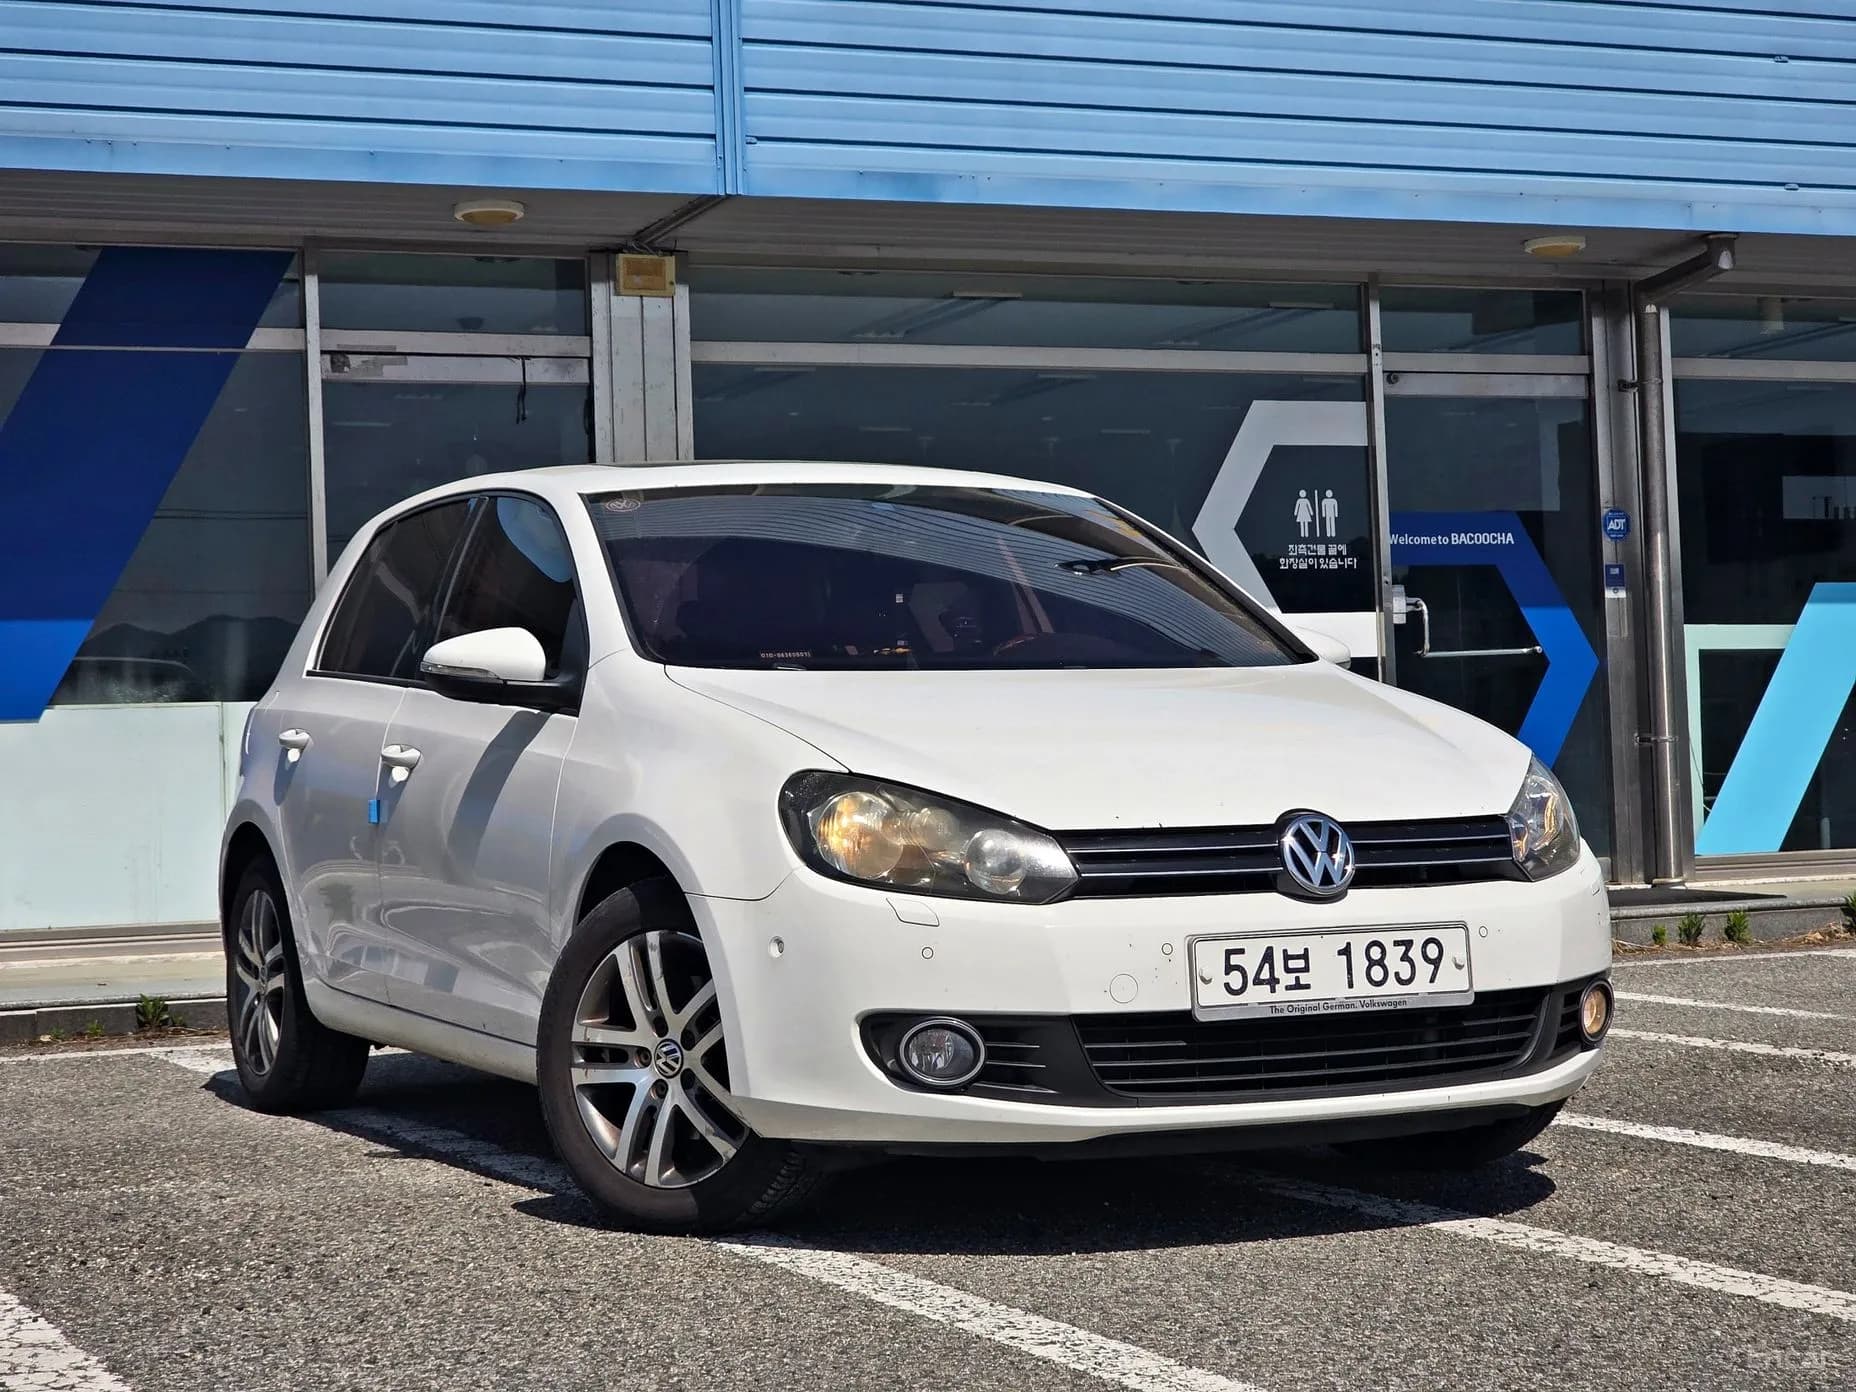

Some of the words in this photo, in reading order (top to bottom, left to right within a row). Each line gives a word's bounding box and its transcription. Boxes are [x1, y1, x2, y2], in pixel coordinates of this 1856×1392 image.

[1607, 518, 1625, 530] ADT
[1451, 532, 1515, 545] BACOOCHA
[1288, 544, 1326, 556] 좌측건물
[1328, 544, 1347, 556] 끝에
[1279, 557, 1318, 569] 화장실이
[1319, 557, 1357, 569] 있습니다
[1223, 946, 1311, 996] 54보
[1337, 937, 1444, 989] 1839
[1269, 1005, 1285, 1014] The
[1286, 1002, 1321, 1015] Original
[1359, 999, 1407, 1009] Volkswagen
